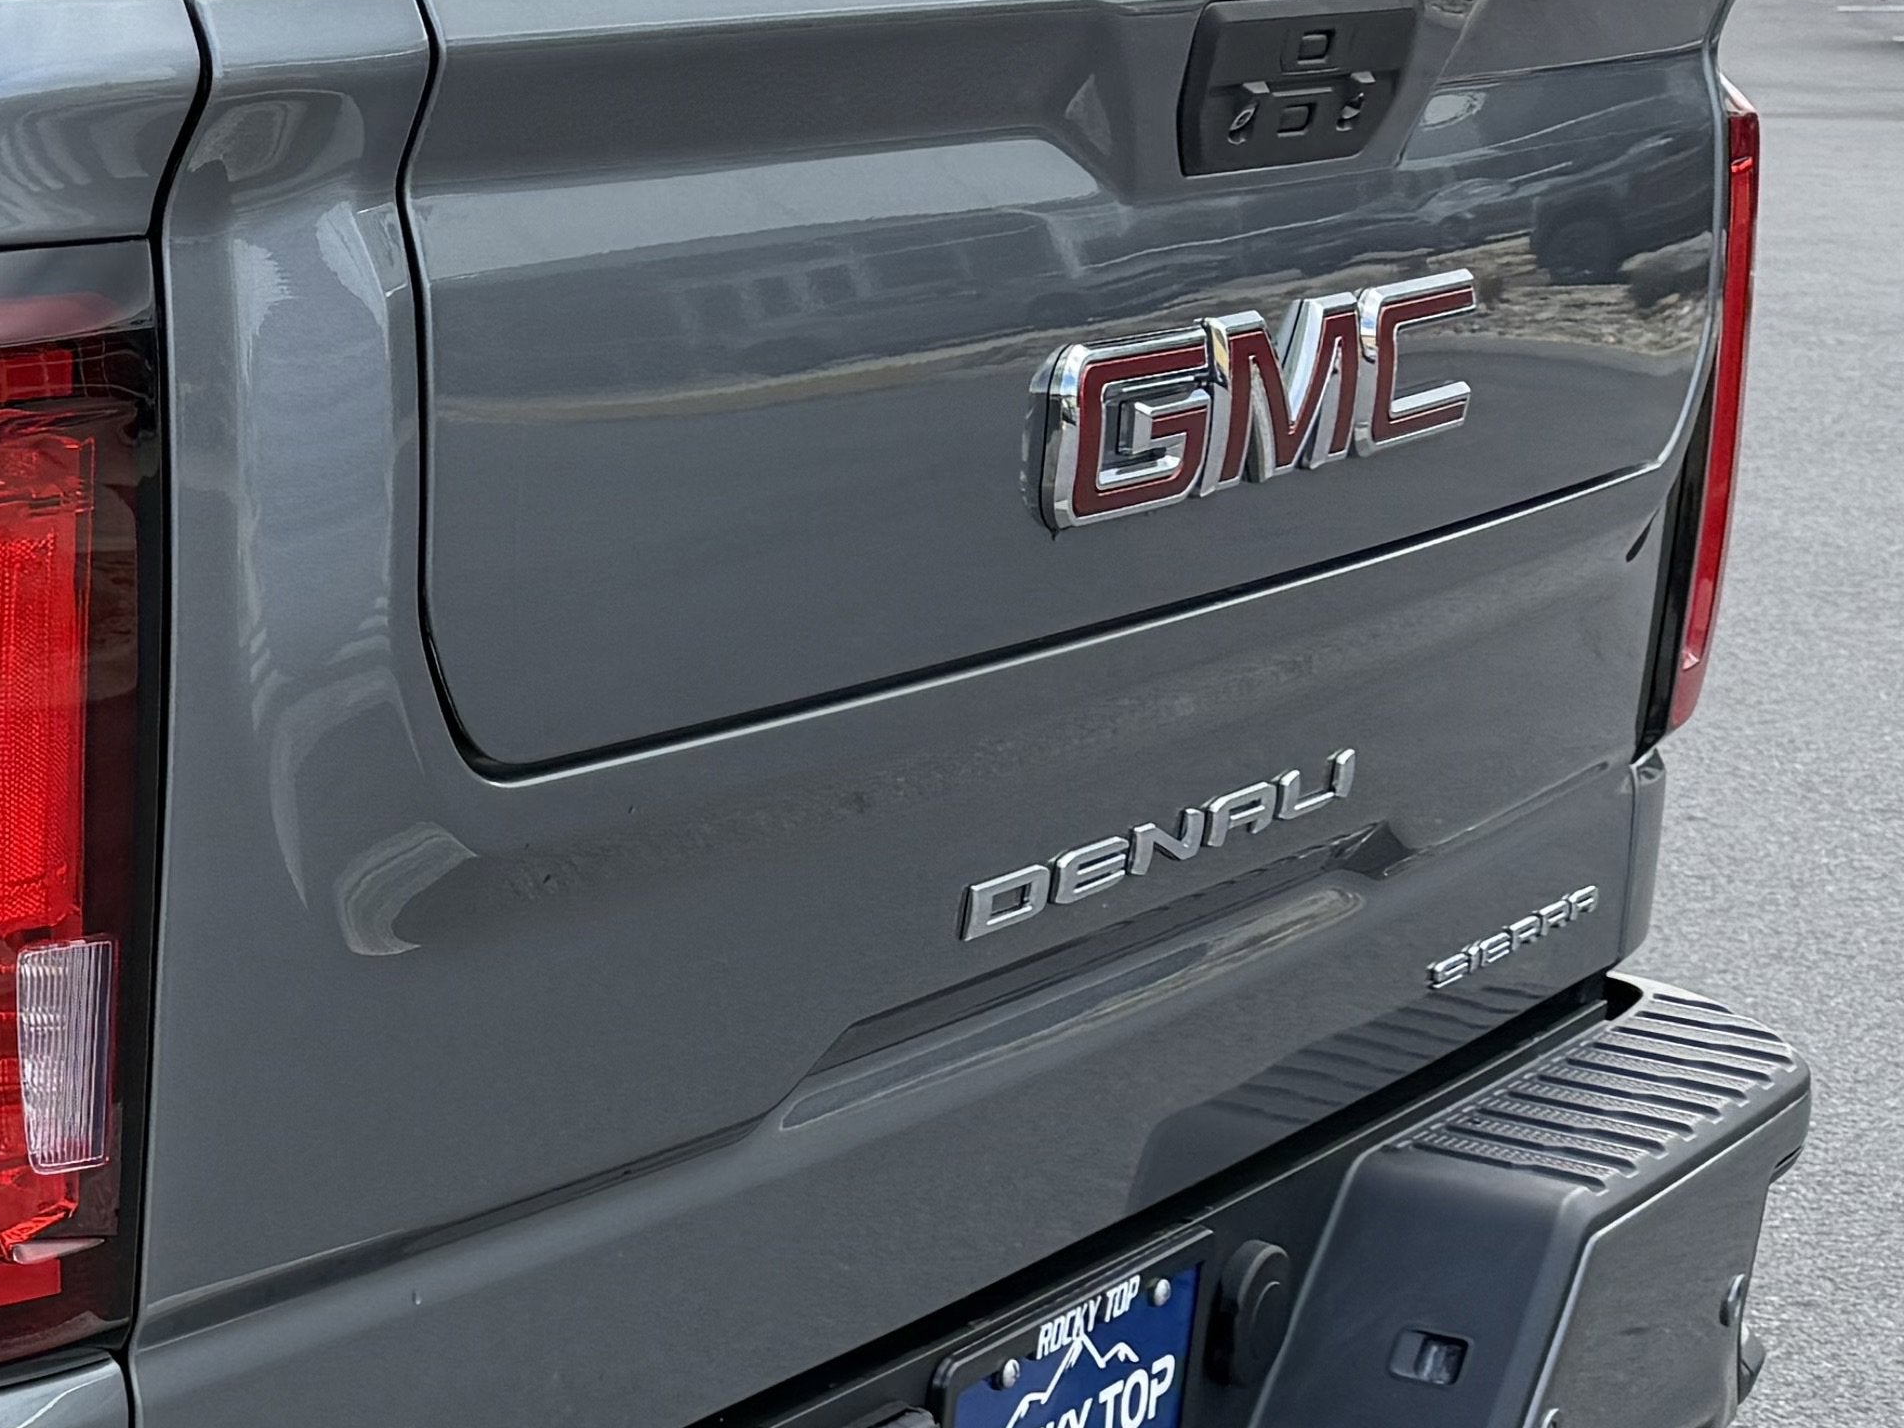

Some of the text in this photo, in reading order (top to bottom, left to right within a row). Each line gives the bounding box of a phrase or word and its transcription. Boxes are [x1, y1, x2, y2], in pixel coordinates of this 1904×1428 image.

[1022, 268, 1476, 530] GMC
[959, 748, 1356, 942] DENALI
[1426, 884, 1599, 989] SIERRA
[1036, 1274, 1141, 1361] ROCKY TOP
